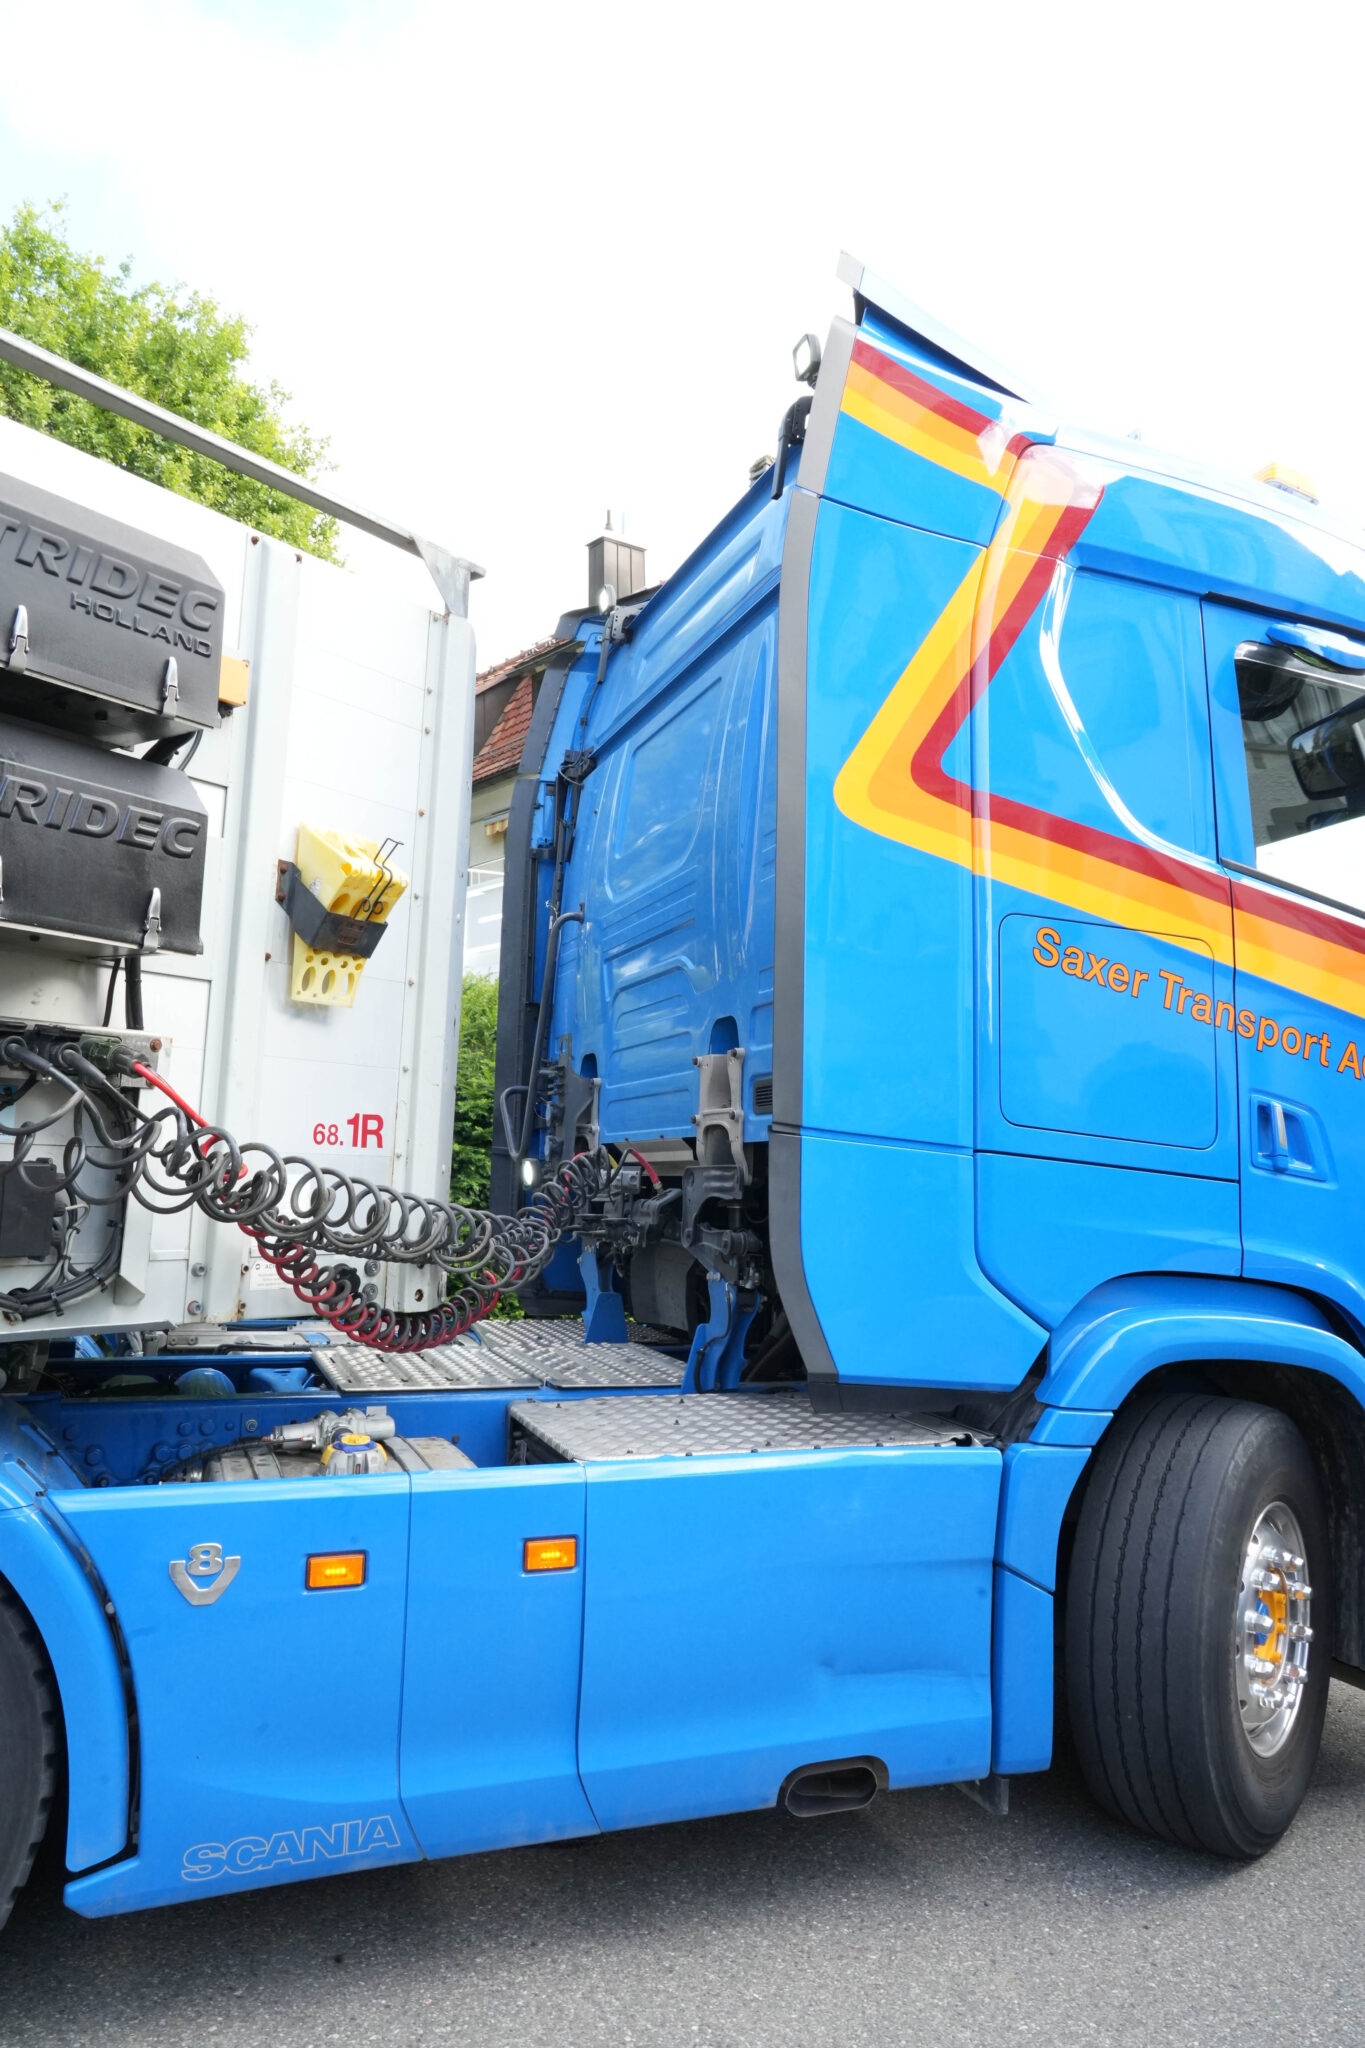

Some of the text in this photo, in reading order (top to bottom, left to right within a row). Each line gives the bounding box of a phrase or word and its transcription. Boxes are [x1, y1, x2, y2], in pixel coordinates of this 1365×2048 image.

[70, 590, 213, 658] HOLLAND
[1032, 926, 1365, 1080] Saxer Transport A
[182, 1815, 400, 1881] SCANIA
